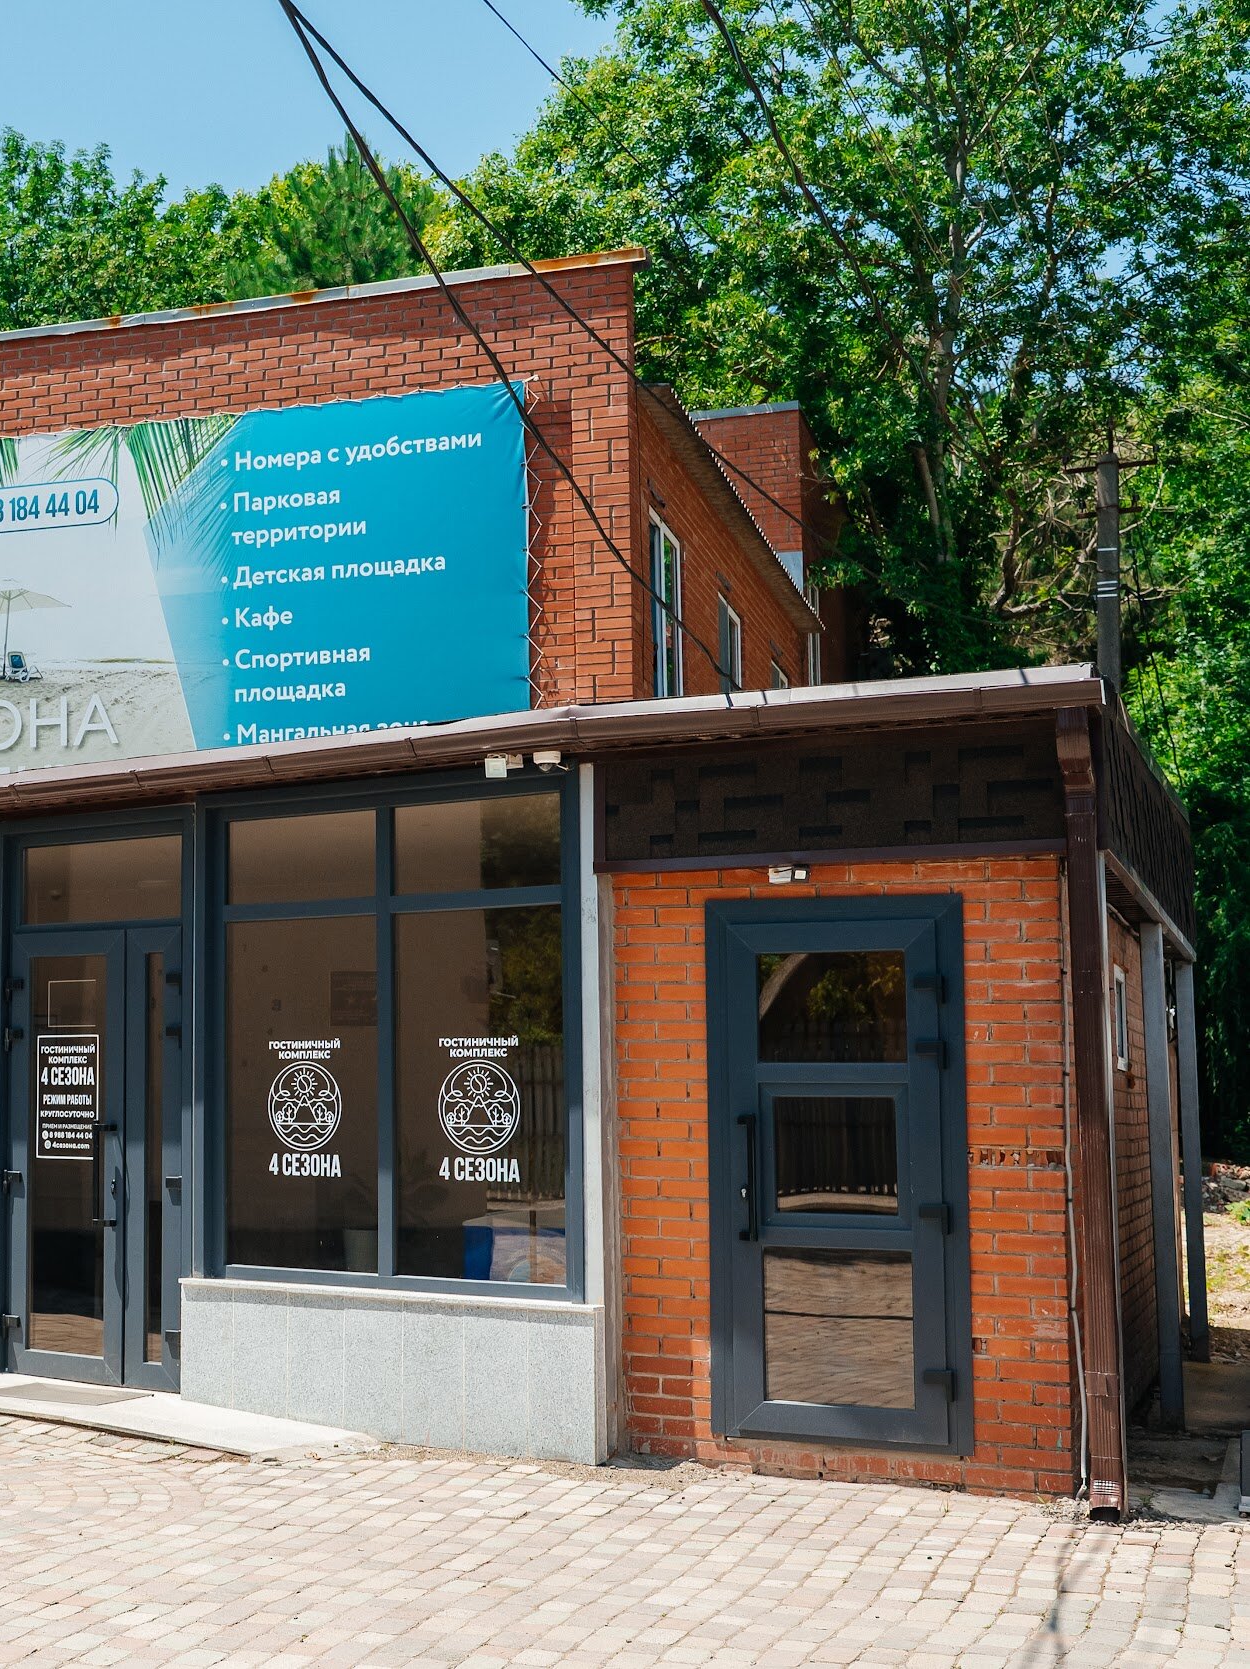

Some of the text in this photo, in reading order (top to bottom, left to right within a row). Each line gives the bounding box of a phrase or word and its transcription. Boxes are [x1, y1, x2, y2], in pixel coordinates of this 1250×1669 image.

[234, 433, 483, 472] Номера с удобствами
[9, 494, 40, 521] 184
[45, 491, 70, 517] 44
[75, 489, 100, 515] 04
[233, 489, 341, 515] Парковая
[231, 519, 367, 547] территории
[233, 553, 447, 589] Детская площадка
[234, 605, 293, 632] Кафе
[234, 646, 371, 672] Спортивная
[234, 682, 347, 703] площадка
[41, 1044, 96, 1054] ГОСТИНИЧНЫЙ
[268, 1037, 341, 1050] ГОСТИНИЧНЫЙ
[438, 1034, 519, 1048] ГОСТИНИЧНЫЙ
[48, 1056, 88, 1064] КОМПЛЕКС
[278, 1050, 331, 1060] КОМПЛЕКС
[449, 1047, 508, 1058] КОМПЛЕКС
[40, 1066, 95, 1086] 4 СЕЗОНА
[43, 1094, 92, 1105] РЕЖИМ РАБОТЫ
[40, 1110, 95, 1119] КРУГЛОСУТОЧНО
[54, 1131, 65, 1139] 988
[65, 1131, 75, 1139] 184
[84, 1132, 93, 1140] 04
[268, 1153, 342, 1178] 4 СЕЗОНА
[438, 1157, 521, 1183] 4 СЕЗОНА
